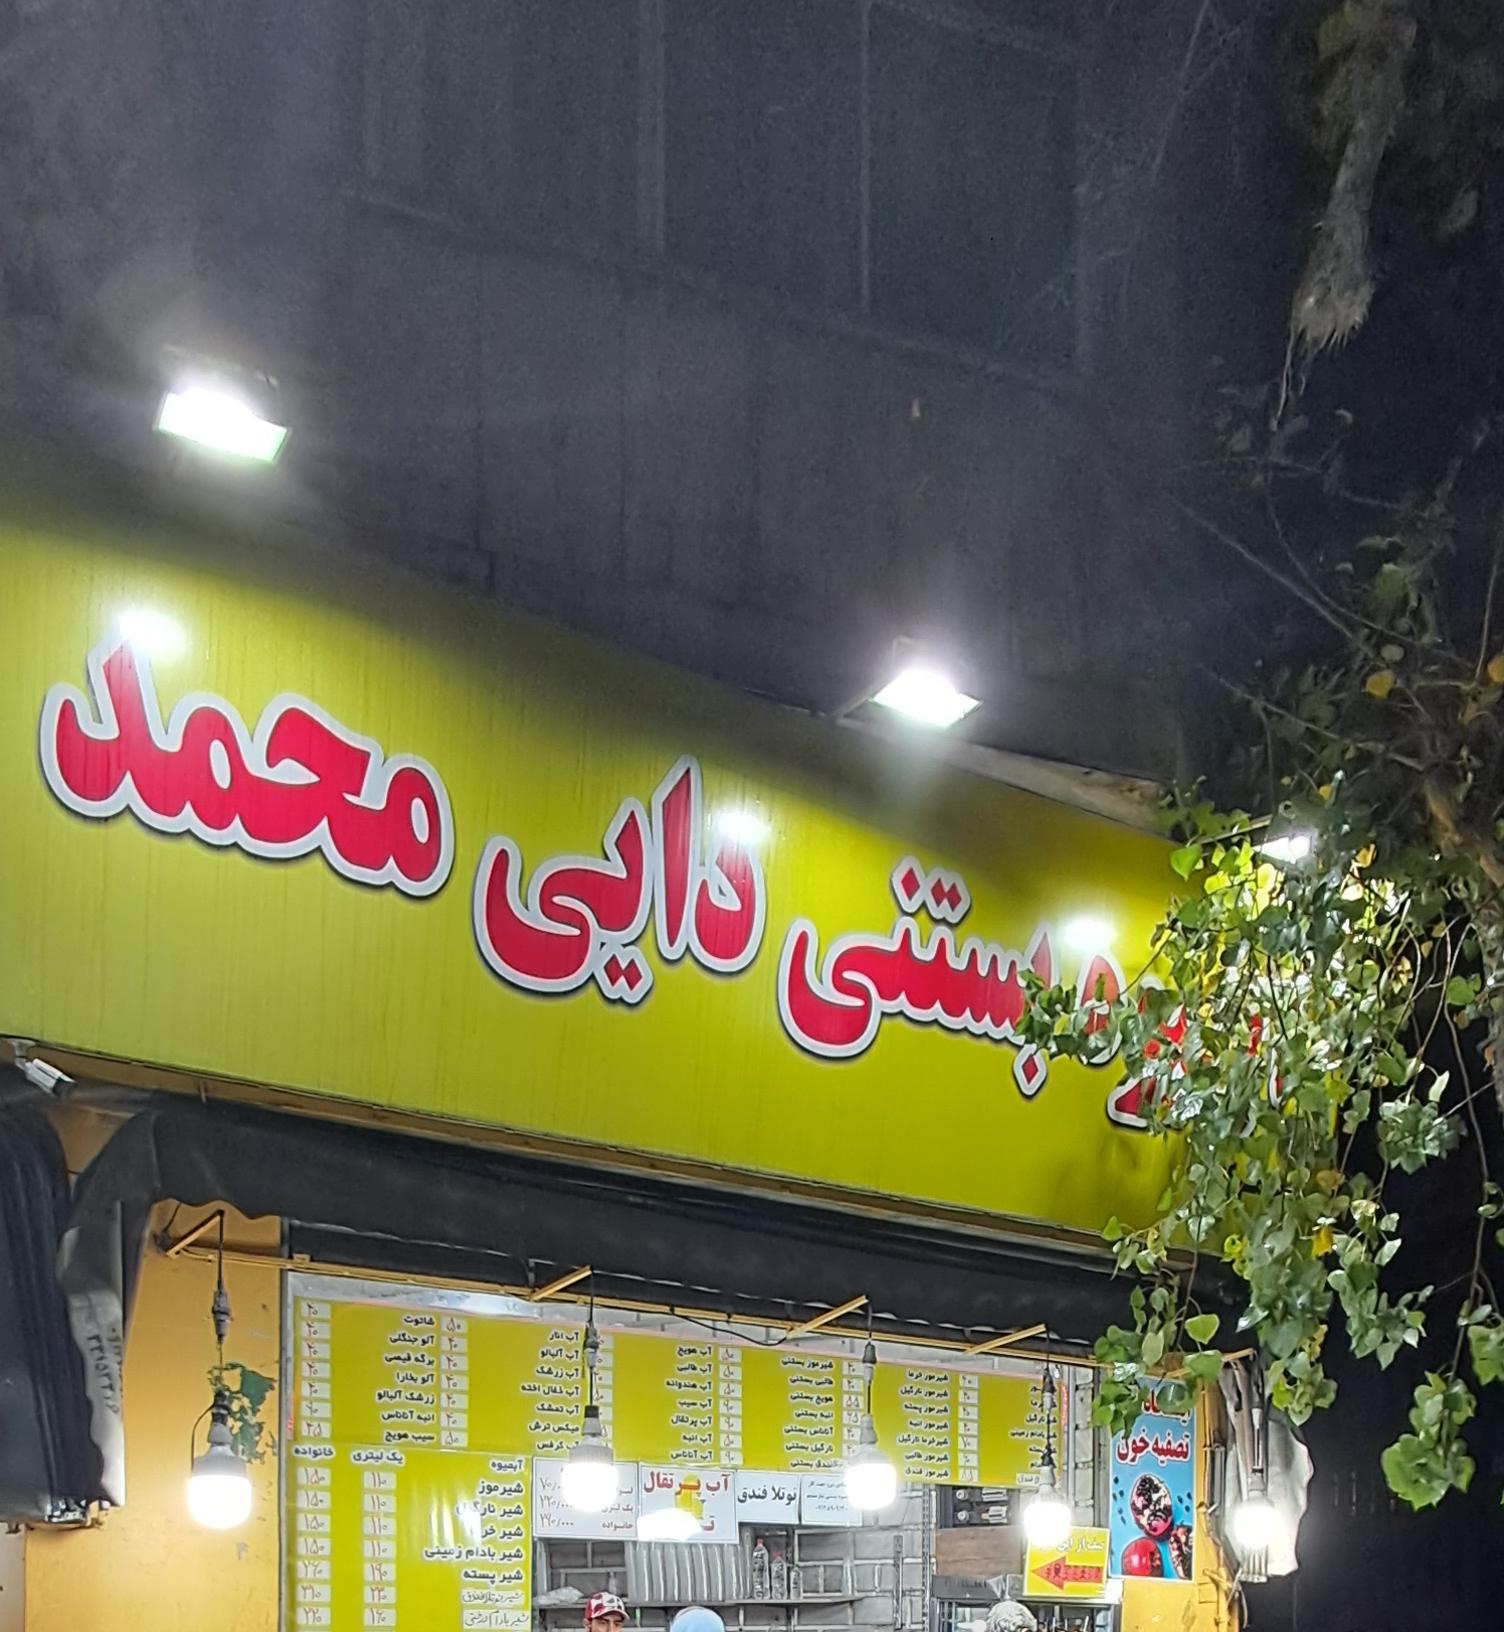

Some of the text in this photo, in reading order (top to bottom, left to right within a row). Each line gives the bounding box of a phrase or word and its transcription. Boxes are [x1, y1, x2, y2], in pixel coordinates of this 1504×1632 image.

[48, 638, 447, 890] محمد
[480, 764, 760, 998] دایی
[784, 862, 1056, 1086] بستنی
[404, 1316, 434, 1326] شاتوت
[390, 1333, 434, 1346] آلو جنگلی
[550, 1331, 579, 1341] آب انار
[541, 1349, 579, 1360] آب آلبالو
[700, 1346, 711, 1356] آب
[536, 1366, 579, 1378] آب زرشک
[700, 1364, 711, 1374] آب
[421, 1374, 434, 1384] آلو
[566, 1387, 579, 1396] آب
[700, 1382, 711, 1391] آب
[378, 1390, 434, 1404] زرشک آلبالو
[700, 1399, 712, 1408] آب
[382, 1411, 413, 1420] آناناس
[566, 1405, 579, 1415] آب
[672, 1416, 712, 1427] آب پرتقال
[700, 1434, 712, 1443] آب
[1117, 1428, 1189, 1464] تصفیه خون
[294, 1448, 333, 1458] خانواده
[353, 1452, 403, 1464] یک لیتری
[671, 1450, 712, 1459] آب آناناس
[492, 1460, 522, 1471] آبمیوه
[644, 1472, 730, 1496] آب پرتقال
[738, 1488, 768, 1504] فندق
[772, 1488, 796, 1506] نوتلا
[500, 1505, 523, 1517] شیر
[499, 1526, 523, 1538] شیر
[425, 1546, 523, 1560] شیر بادام زمینی
[464, 1570, 523, 1584] شیر پسته
